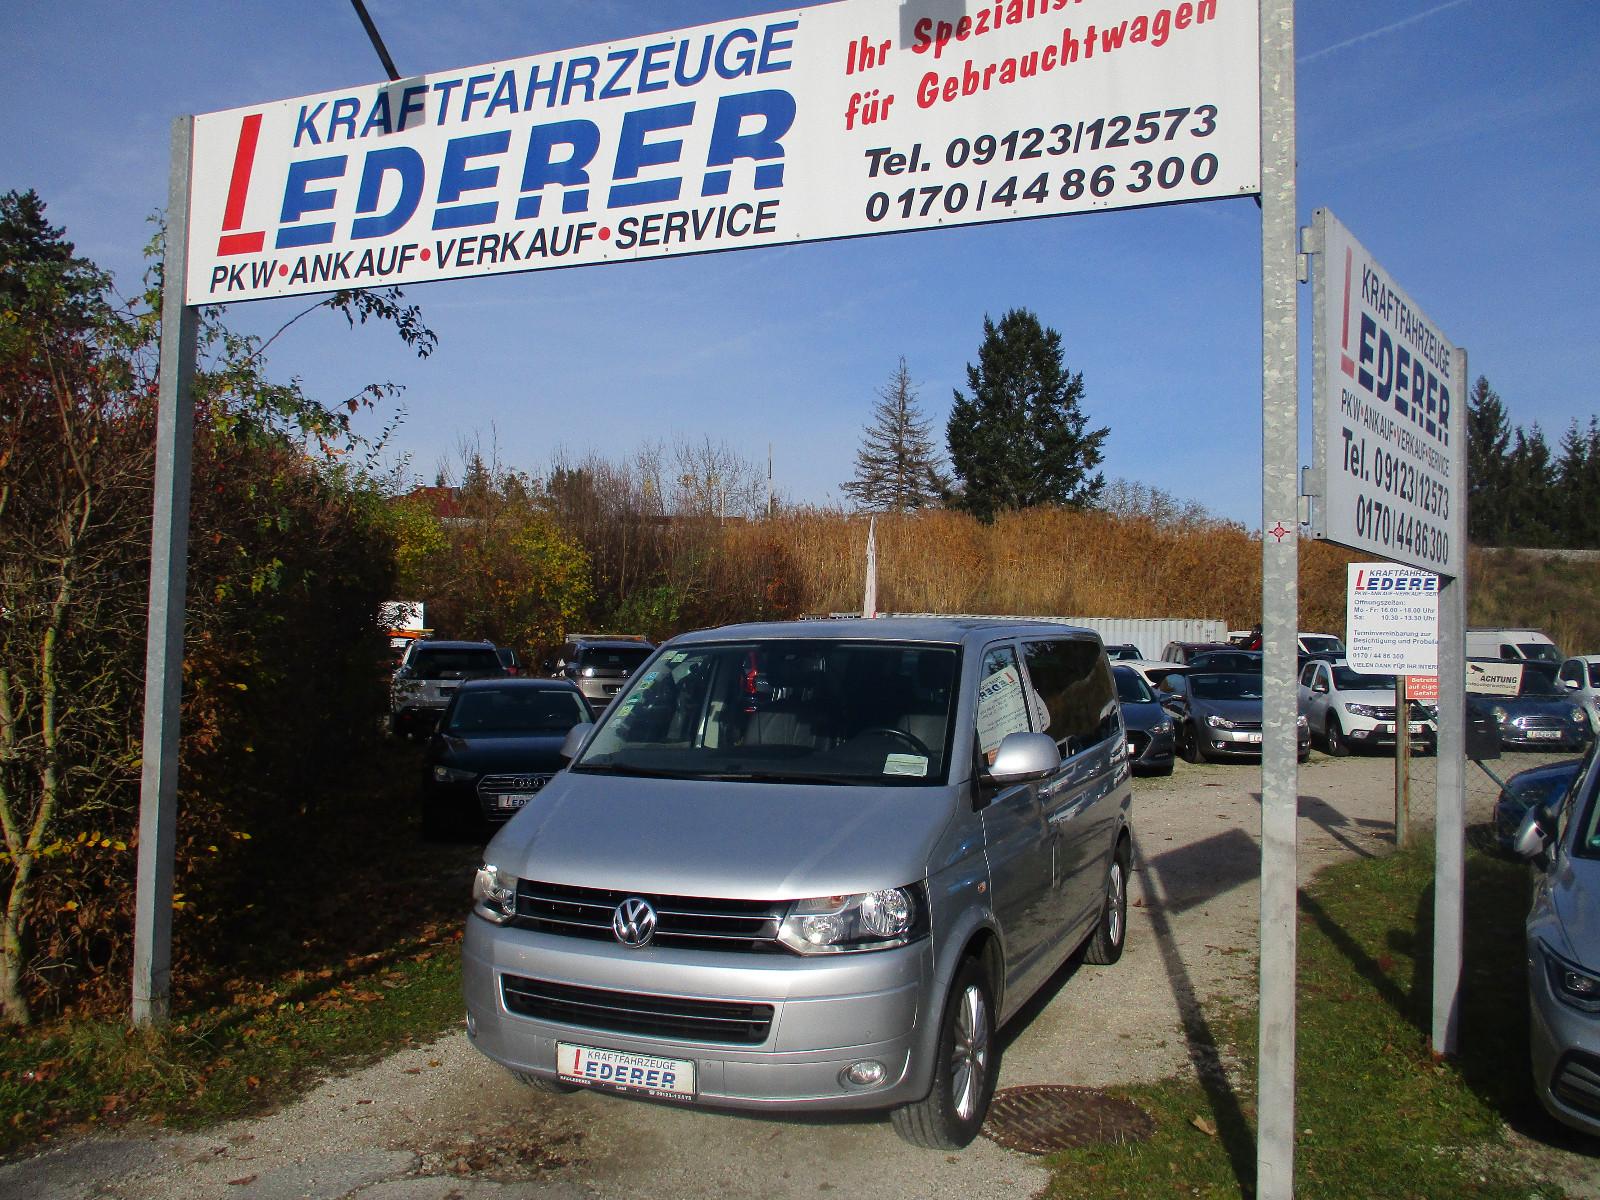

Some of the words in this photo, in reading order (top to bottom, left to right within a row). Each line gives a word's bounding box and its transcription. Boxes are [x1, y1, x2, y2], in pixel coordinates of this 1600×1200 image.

[293, 20, 801, 149] KRAFTFAHRZEUGE
[844, 88, 895, 131] für
[916, 0, 1218, 109] Gebrauchtwagen
[845, 35, 893, 76] Ihr
[217, 89, 797, 257] LEDERER
[864, 144, 931, 179] Tel.
[209, 260, 278, 294] PKW
[289, 244, 419, 286] ANKAUF
[436, 222, 598, 271] VERKAUF
[616, 199, 780, 251] SERVICE
[1340, 246, 1450, 447] LEDERER
[1361, 263, 1450, 379] KRAFTFAHRZEUGE
[1342, 426, 1369, 481] Tel.
[1363, 404, 1394, 443] ANKAUF
[1396, 425, 1426, 463] VERKAUF
[1427, 447, 1450, 478] SERVICE
[1480, 675, 1518, 683] ACHTUNG
[573, 1048, 676, 1089] LEDERER
[587, 1050, 676, 1071] KRAFTFAHRZEUGE
